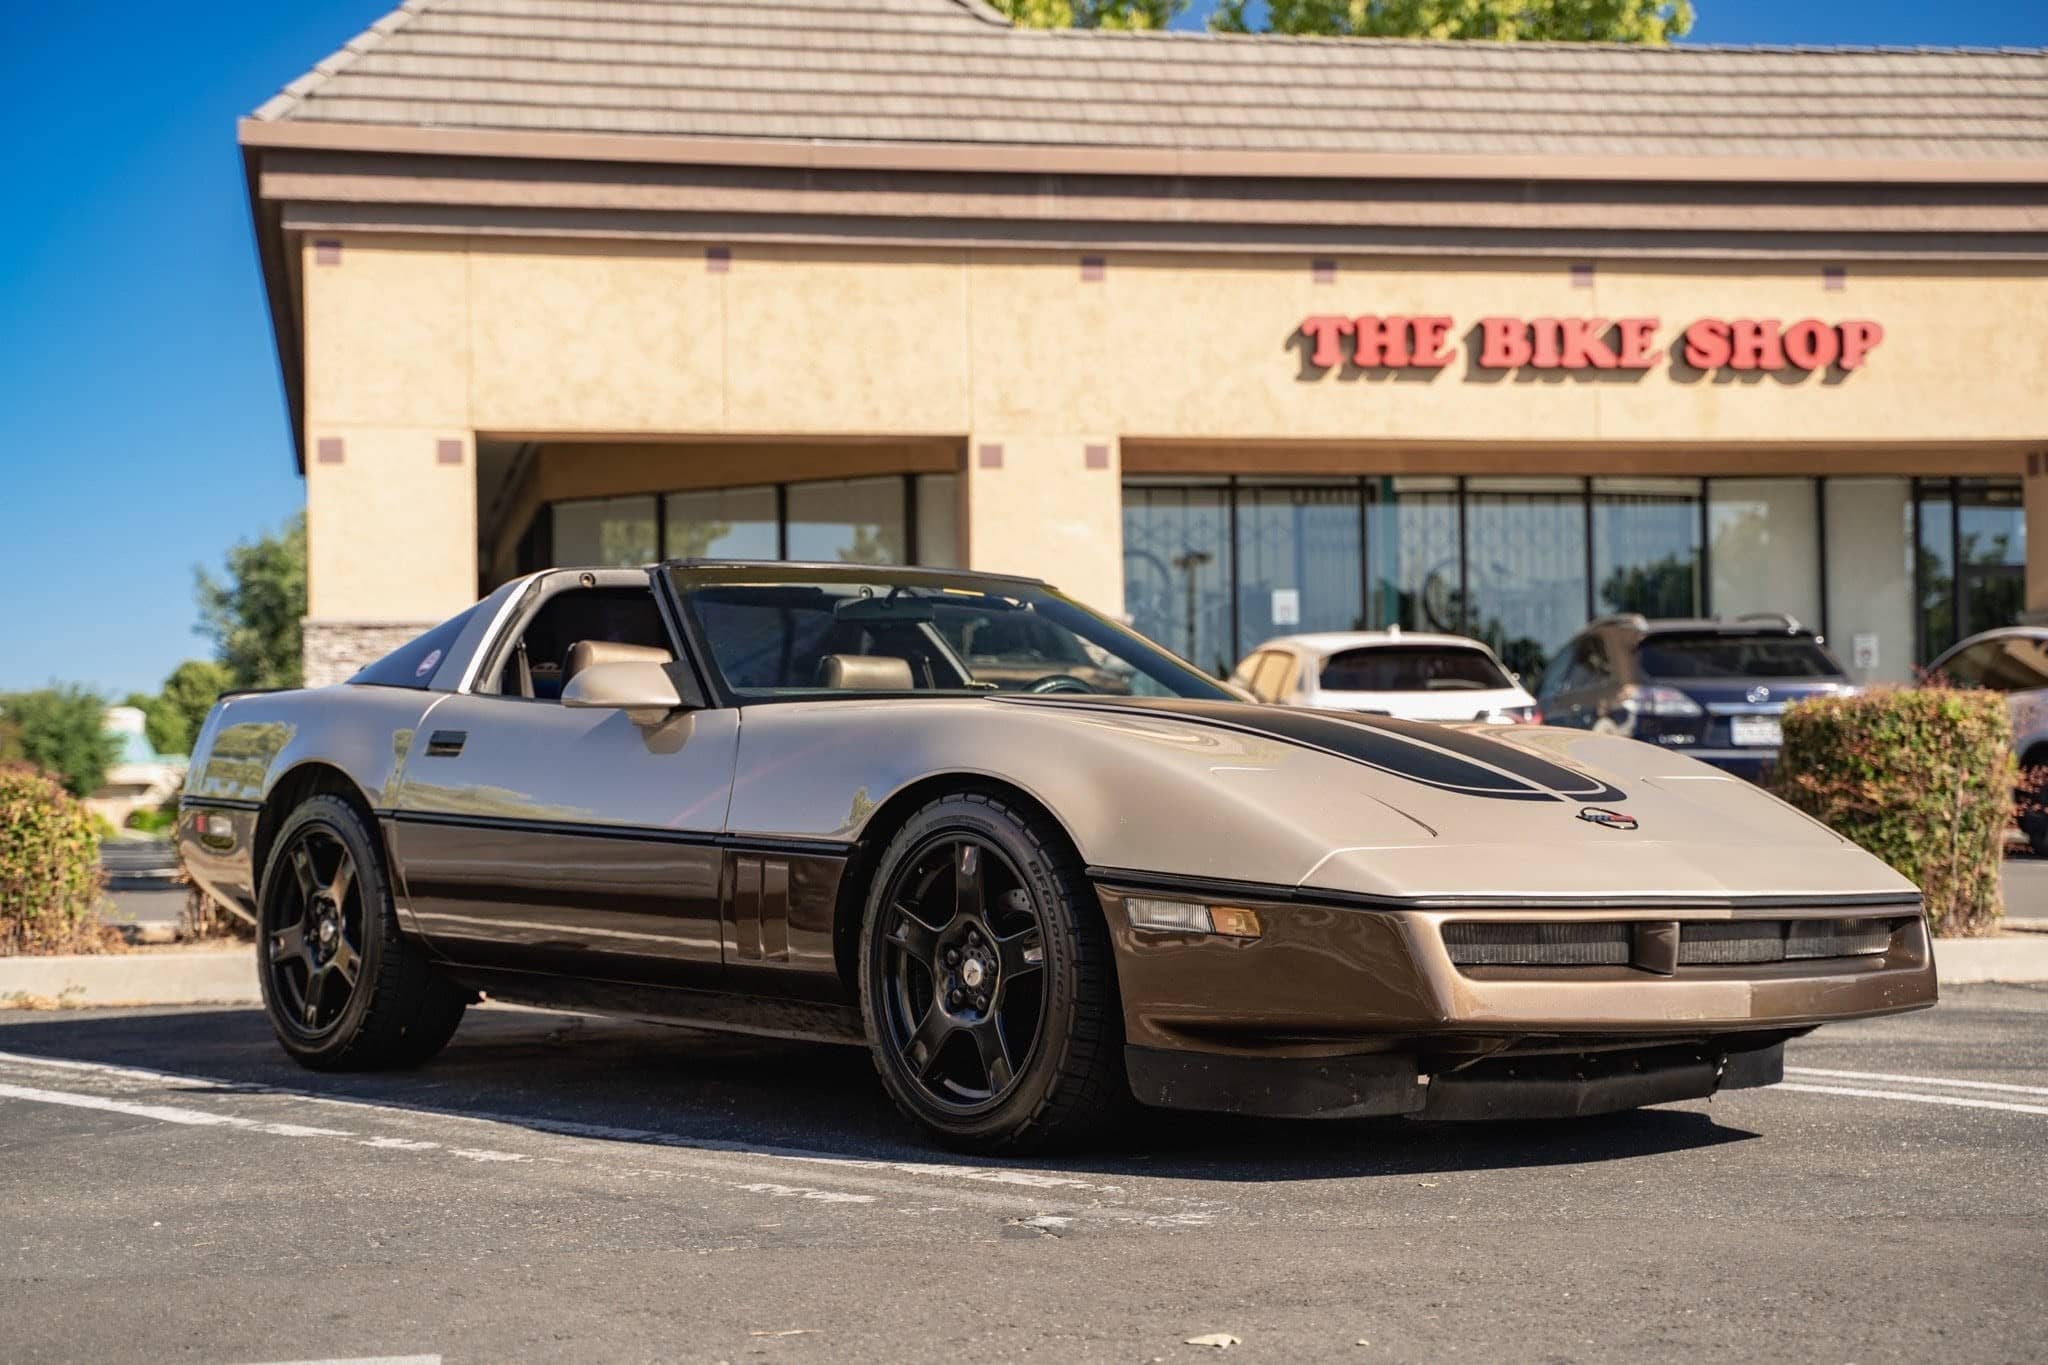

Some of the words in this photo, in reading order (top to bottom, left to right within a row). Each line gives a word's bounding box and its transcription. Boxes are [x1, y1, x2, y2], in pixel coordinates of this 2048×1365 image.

[1302, 314, 1457, 368] THE
[1479, 316, 1664, 369] BIKE
[1684, 317, 1884, 371] SHOP
[1028, 860, 1065, 1013] BFGoodrich
